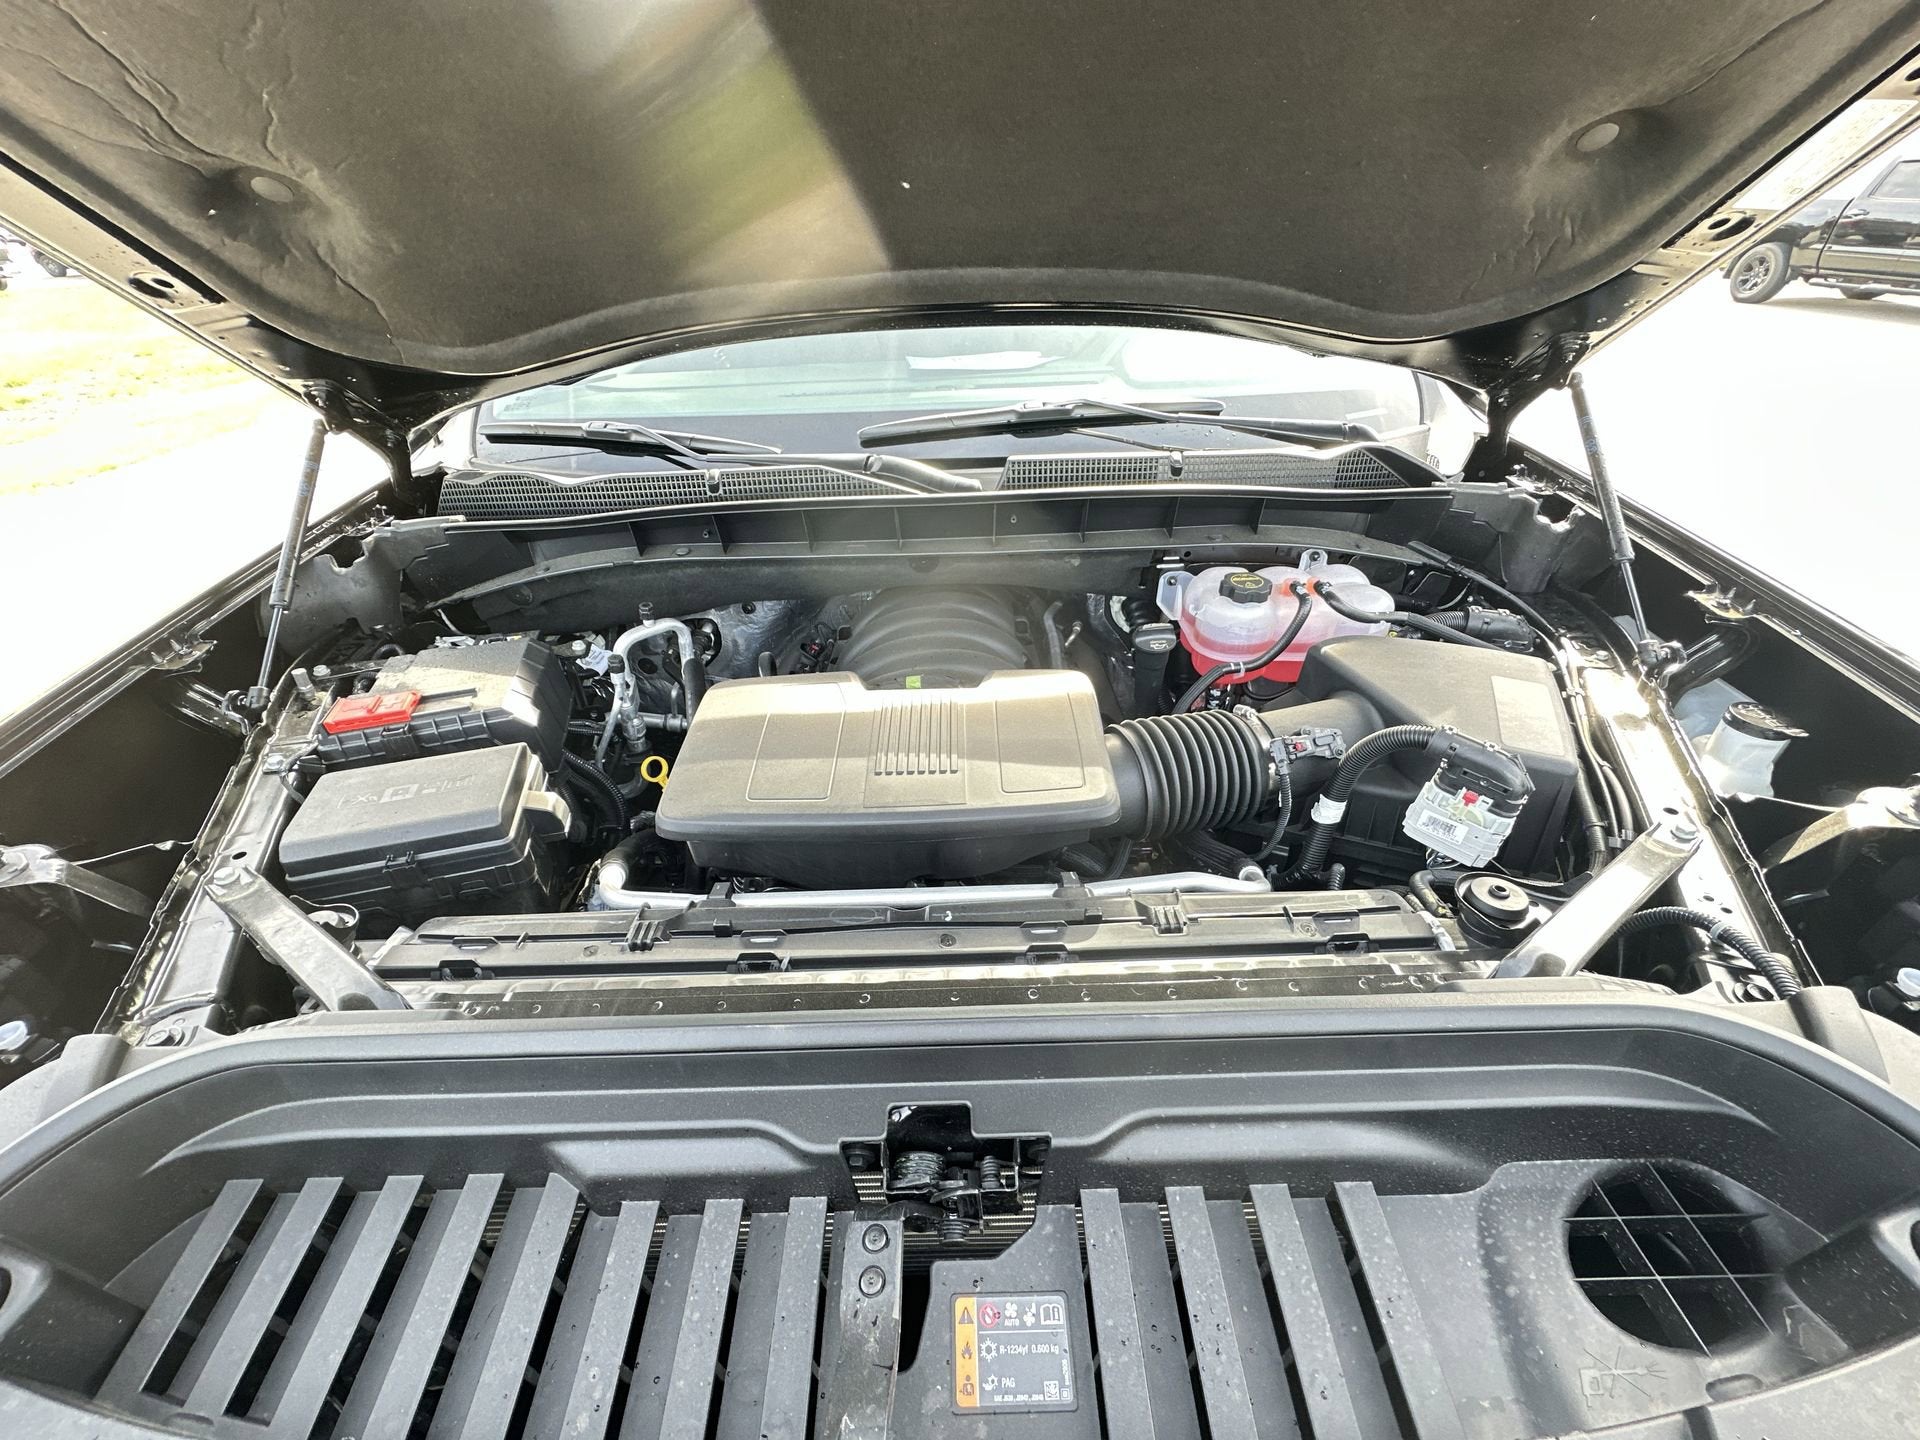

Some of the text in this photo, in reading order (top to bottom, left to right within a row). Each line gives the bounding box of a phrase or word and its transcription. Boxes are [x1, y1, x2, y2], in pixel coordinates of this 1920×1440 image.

[1004, 1318, 1020, 1326] AUTO
[999, 1344, 1029, 1356] R-1234yf
[1050, 1343, 1060, 1355] kg
[1001, 1377, 1016, 1388] PAG
